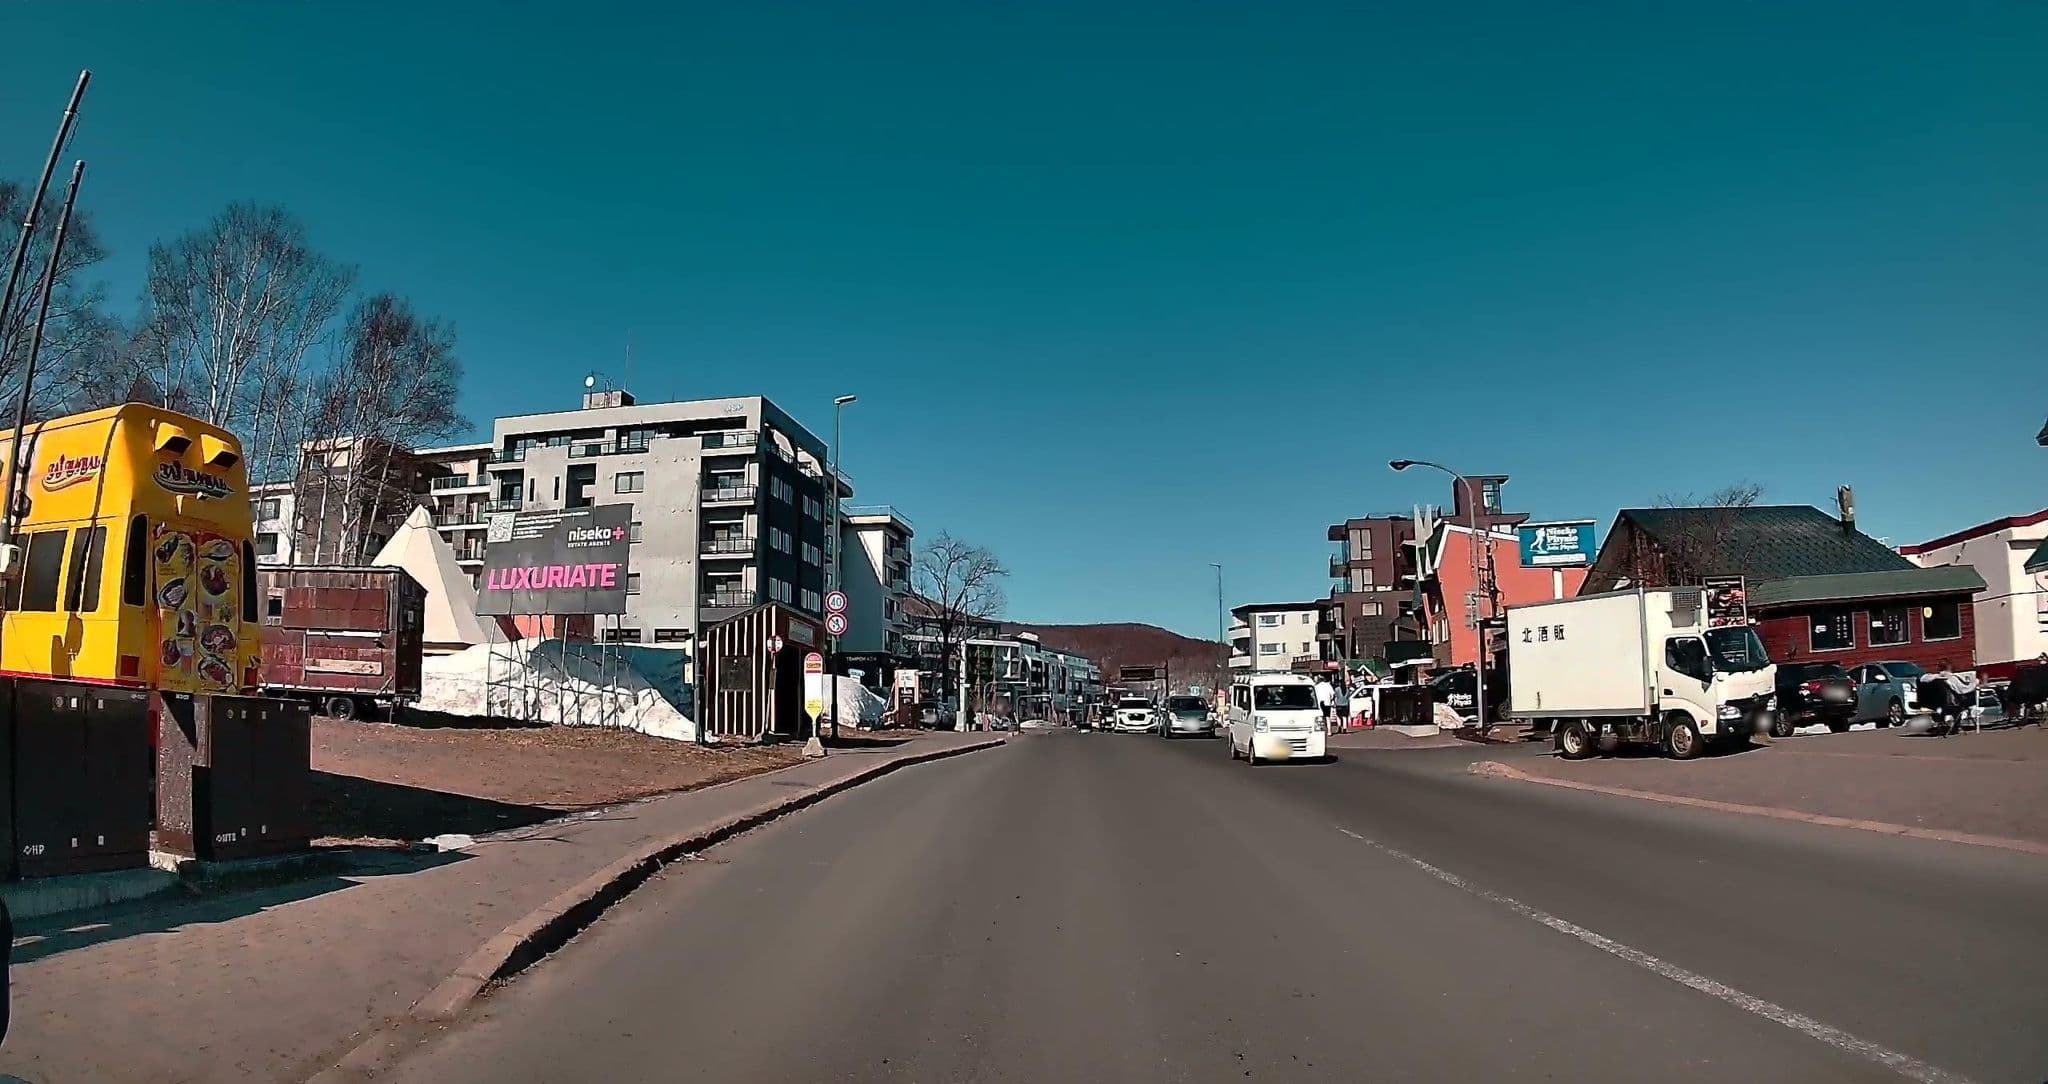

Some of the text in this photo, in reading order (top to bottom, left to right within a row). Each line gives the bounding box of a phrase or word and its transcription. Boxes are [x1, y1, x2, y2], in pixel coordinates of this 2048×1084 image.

[487, 563, 617, 590] LUXURIATE
[831, 598, 842, 607] 40
[1522, 624, 1565, 643] 北酒販
